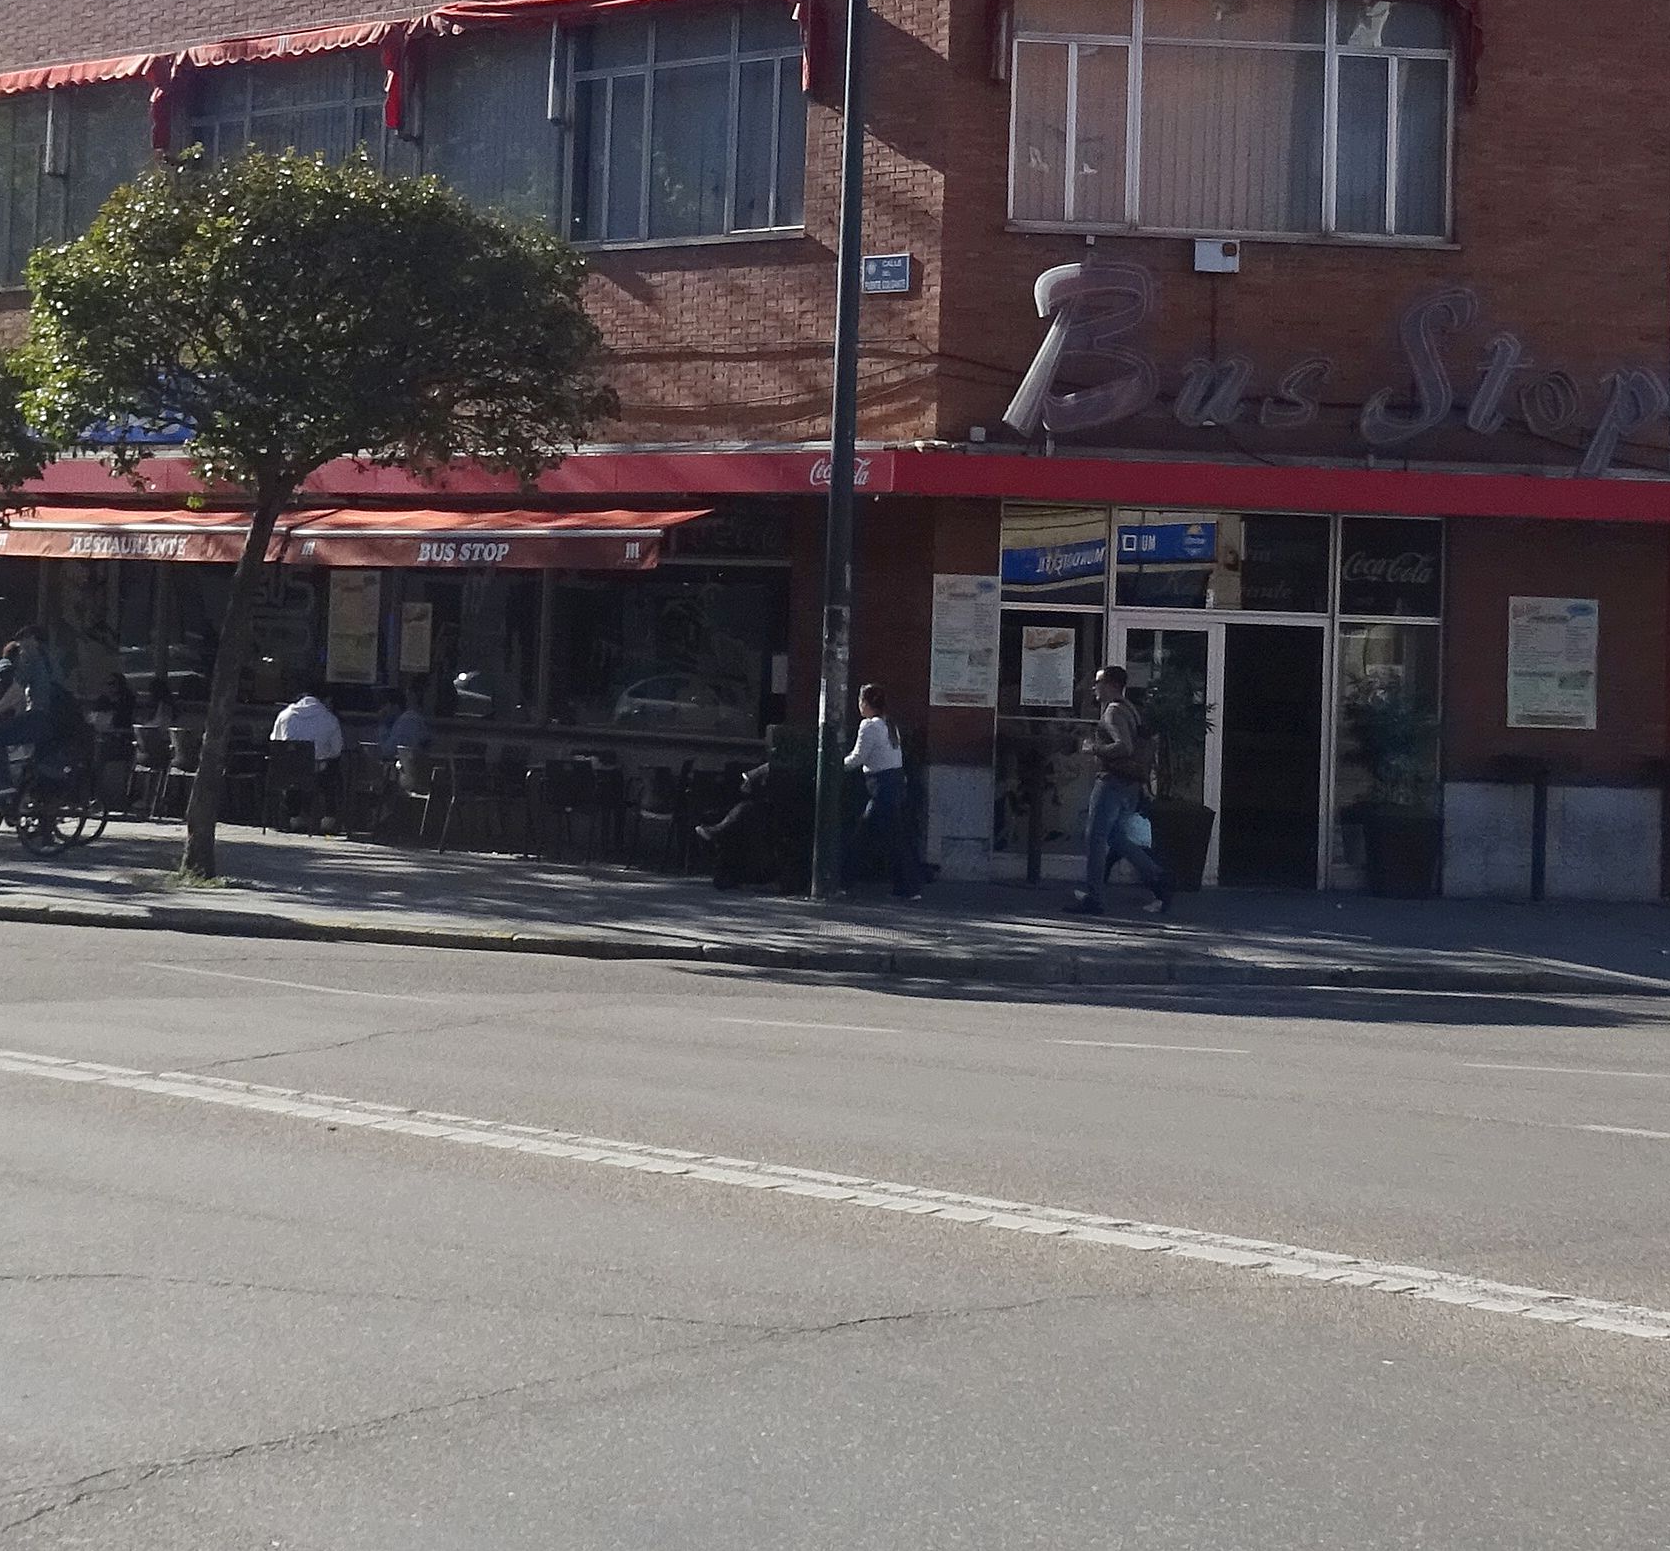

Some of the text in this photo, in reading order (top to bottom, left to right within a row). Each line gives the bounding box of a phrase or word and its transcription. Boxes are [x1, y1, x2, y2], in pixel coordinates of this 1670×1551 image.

[1003, 262, 1670, 476] Bus Stop
[70, 535, 188, 556] RESTAURANTE
[417, 541, 511, 562] BUS STOP
